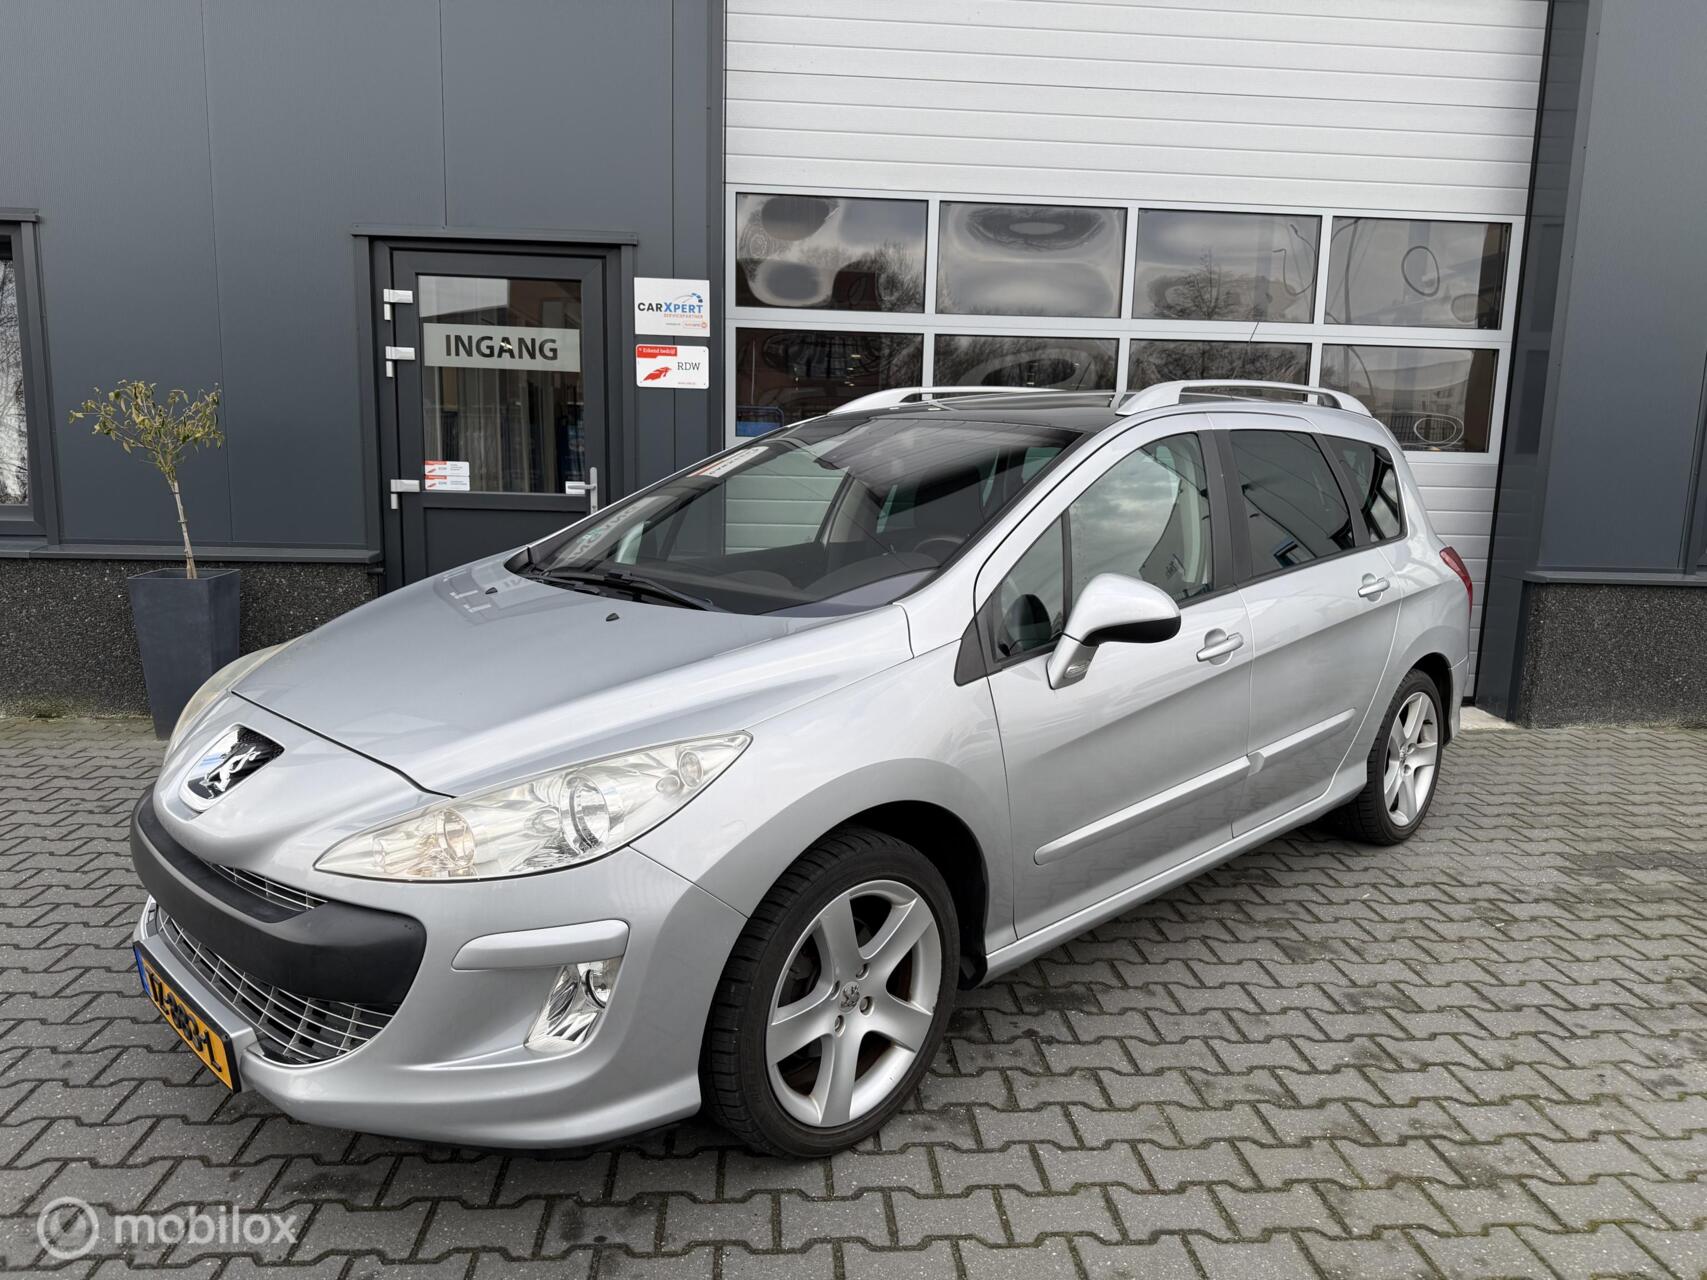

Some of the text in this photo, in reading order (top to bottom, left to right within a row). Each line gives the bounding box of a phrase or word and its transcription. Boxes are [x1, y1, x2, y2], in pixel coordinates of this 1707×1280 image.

[637, 302, 704, 313] CARXPERT
[445, 334, 558, 361] INGANG
[677, 362, 701, 371] RDW
